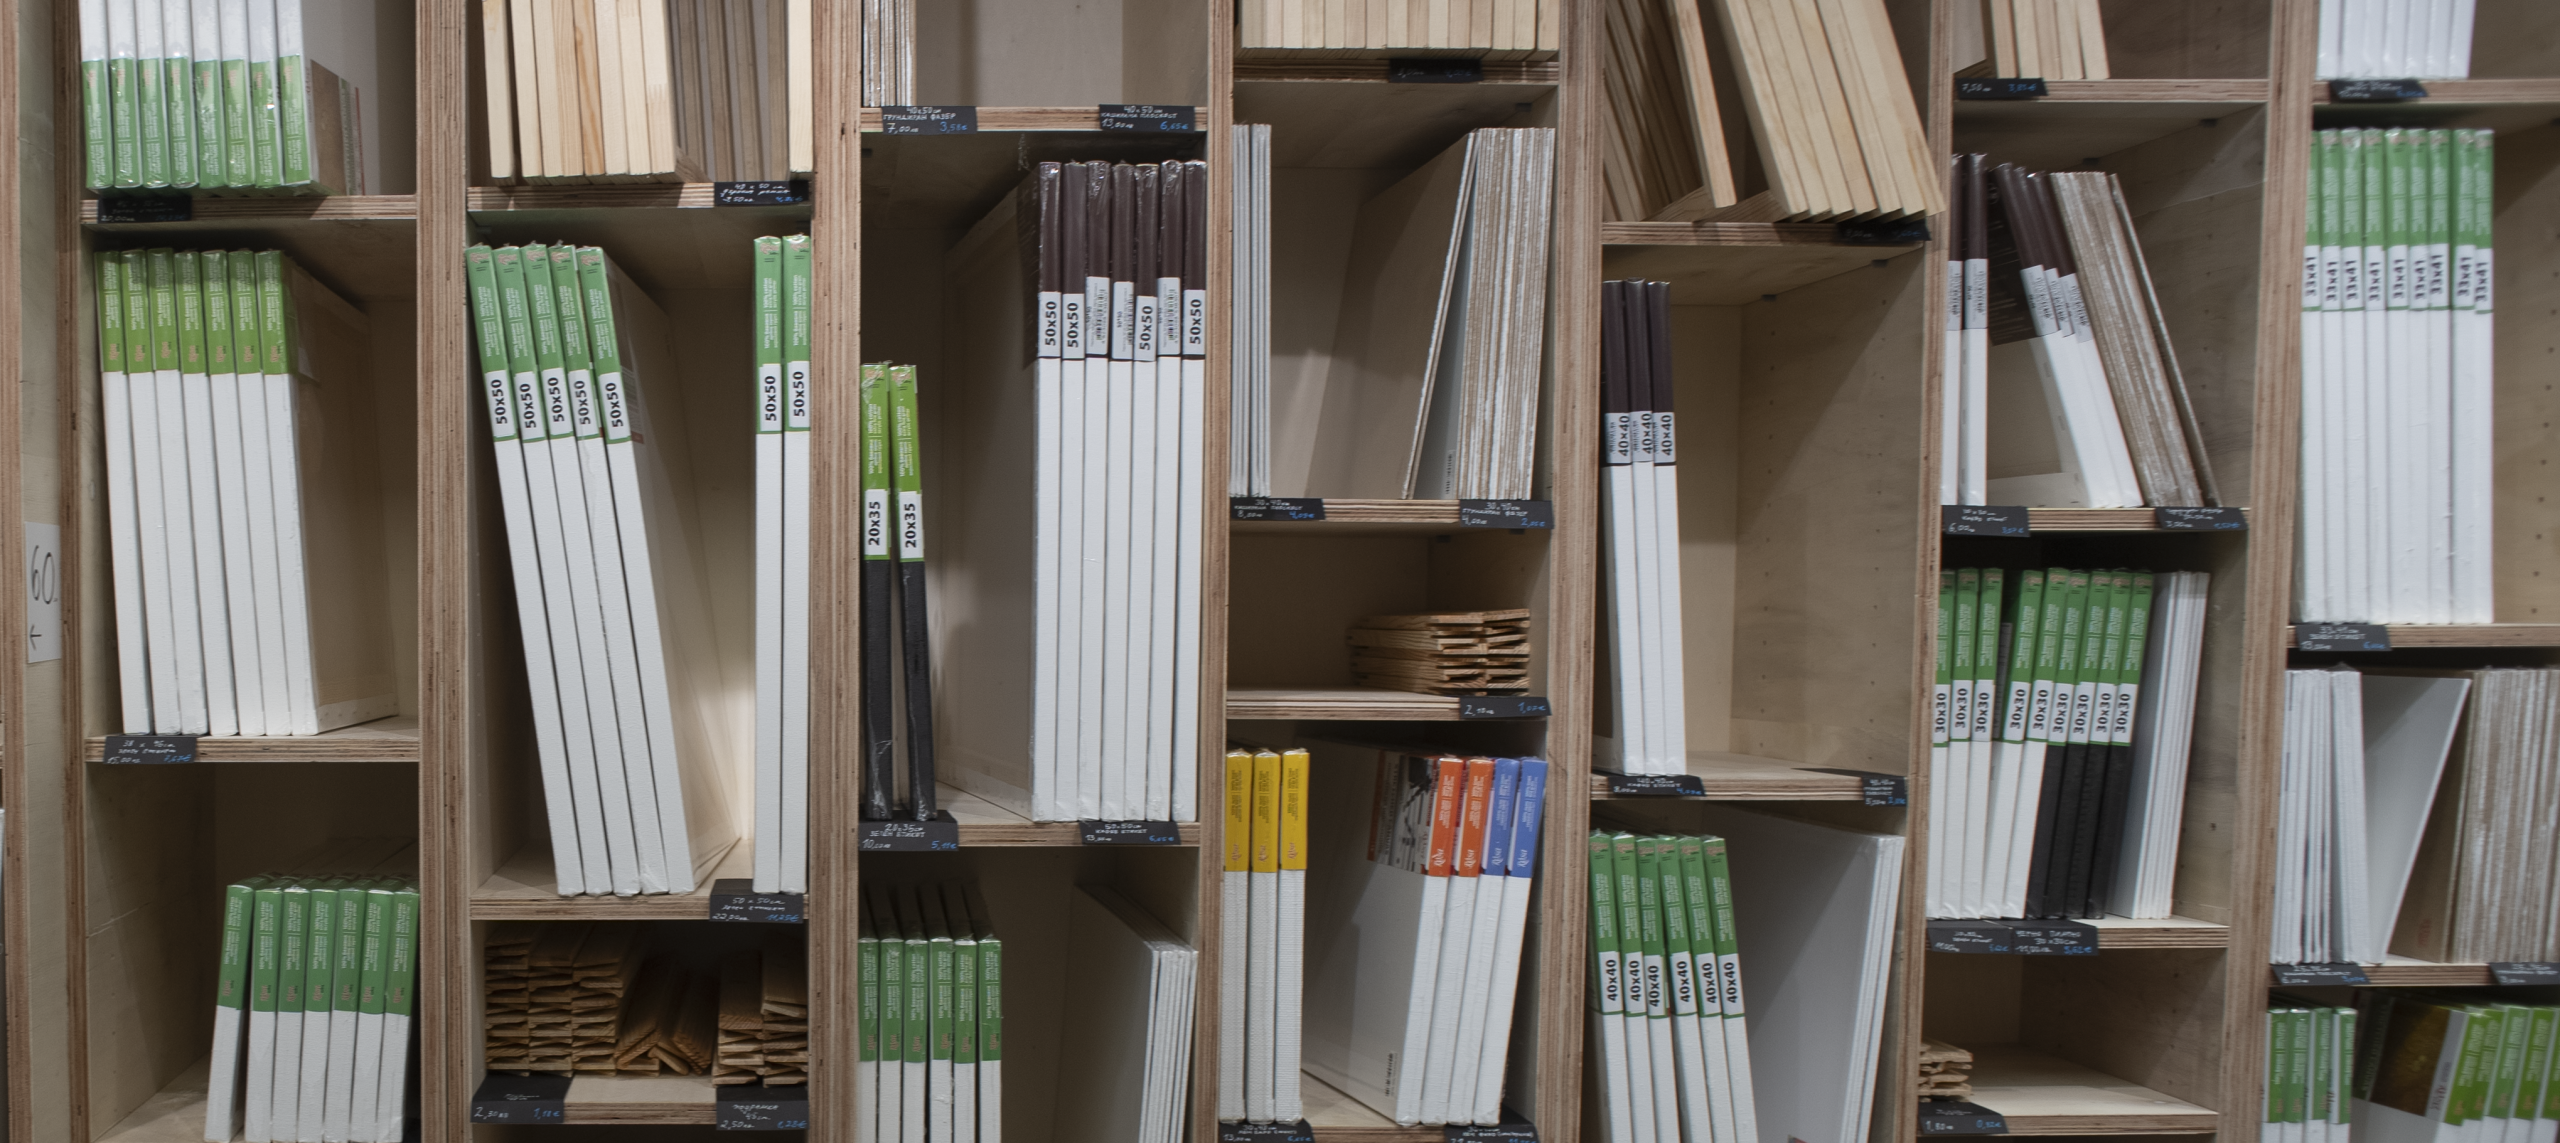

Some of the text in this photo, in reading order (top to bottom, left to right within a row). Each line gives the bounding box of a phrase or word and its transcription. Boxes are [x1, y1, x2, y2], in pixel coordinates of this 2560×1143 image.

[2305, 256, 2317, 296] 33x41
[2326, 261, 2338, 301] 33x41
[2345, 260, 2357, 300] 33x41
[2369, 262, 2380, 301] 33x41
[2393, 258, 2404, 299] 33x41
[2414, 260, 2426, 300] 33x41
[2430, 254, 2442, 294] 33x41
[2457, 256, 2472, 296] 33x41
[2475, 262, 2488, 302] 33x41
[1045, 302, 1057, 346] 50x50
[1067, 302, 1078, 348] 50x50
[1139, 306, 1153, 350] 50x50
[1190, 299, 1202, 344] 50x50
[491, 380, 508, 424] 50x50
[520, 384, 536, 428] 50x50
[548, 378, 564, 422] 50x50
[574, 380, 591, 424] 50x50
[606, 382, 624, 428] 50x50
[766, 375, 777, 422] 50x50
[792, 371, 805, 417] 50x50
[1618, 416, 1630, 456] 40x40
[1641, 414, 1653, 454] 40x40
[1661, 415, 1672, 456] 40x40
[868, 502, 880, 546] 20x35
[904, 503, 917, 548] 20x35
[1935, 692, 1947, 734] 30x30
[1954, 688, 1968, 728] 30x30
[1975, 692, 1989, 733] 30x30
[2010, 689, 2026, 730] 30x30
[2033, 689, 2048, 730] 30x30
[2053, 692, 2068, 734] 30x30
[2074, 694, 2088, 734] 30x30
[2096, 692, 2112, 733] 30x30
[2114, 693, 2130, 734] 30x30
[1606, 960, 1618, 1002] 40x40
[1629, 960, 1641, 1002] 40x40
[1648, 965, 1660, 1007] 40x40
[1676, 960, 1690, 1002] 40x40
[1702, 962, 1717, 1004] 40x40
[1724, 962, 1738, 1004] 40x40
